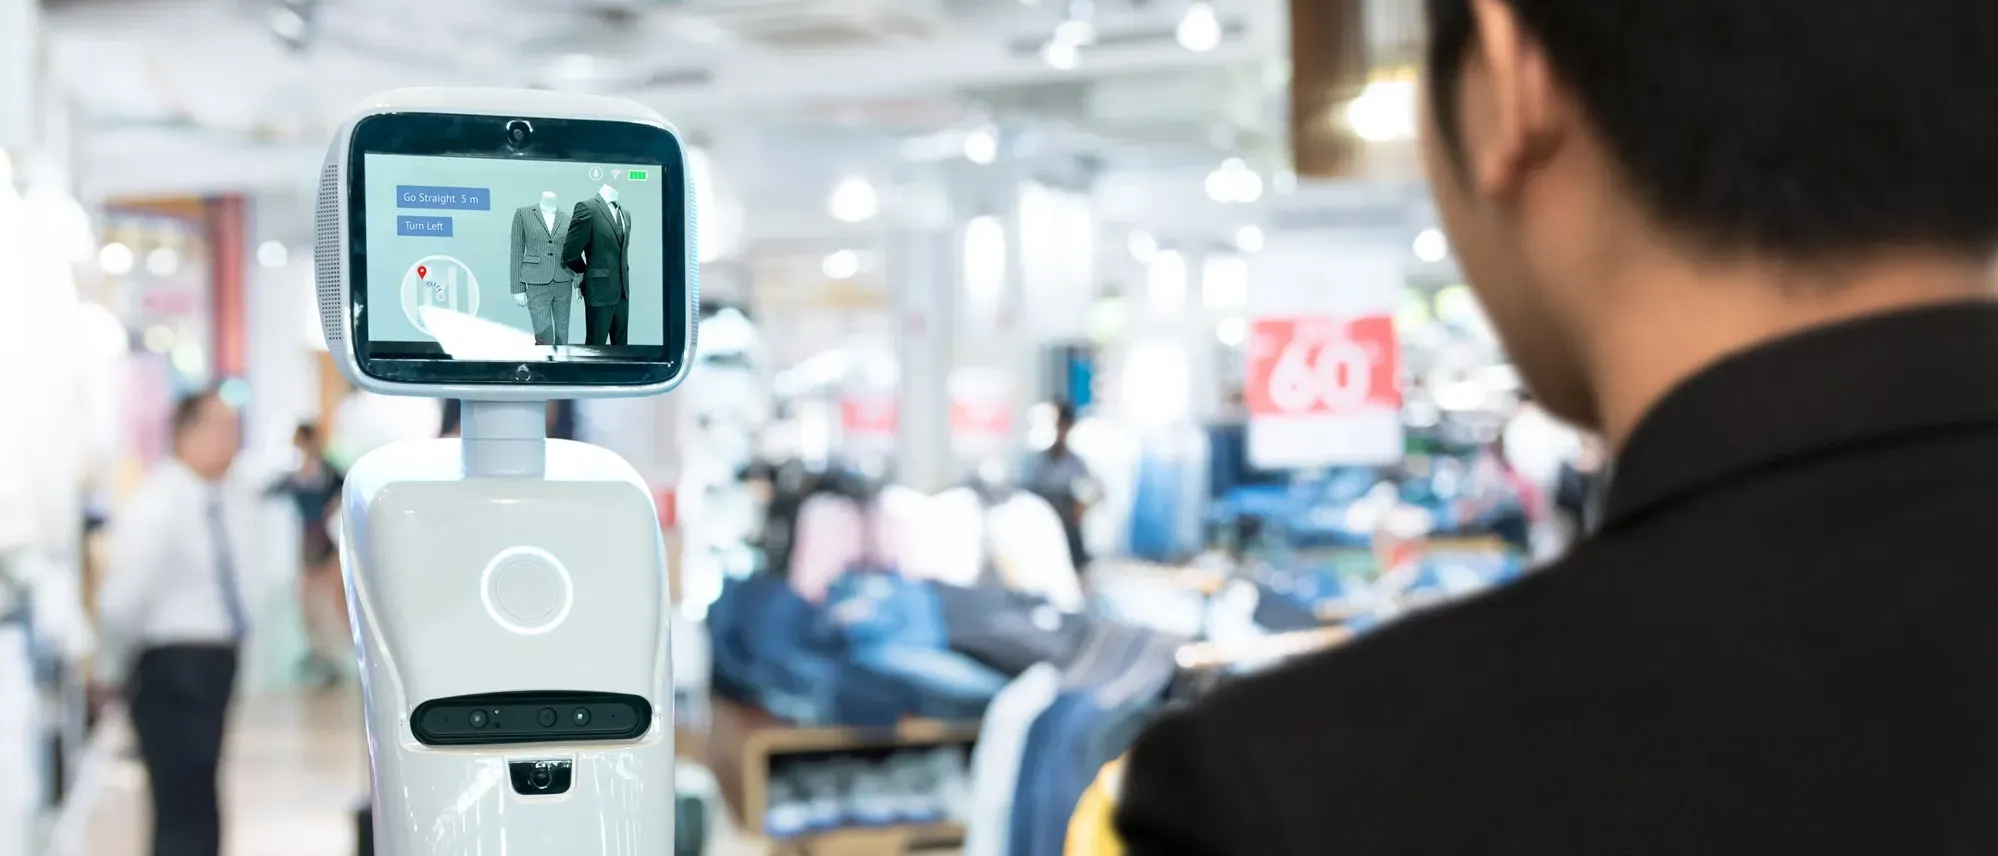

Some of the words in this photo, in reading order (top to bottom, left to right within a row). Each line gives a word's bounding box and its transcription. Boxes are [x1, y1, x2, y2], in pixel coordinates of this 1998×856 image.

[403, 192, 416, 202] Go
[419, 193, 456, 205] Straight
[461, 194, 467, 204] 5
[405, 220, 425, 230] Turn
[427, 221, 443, 231] Left
